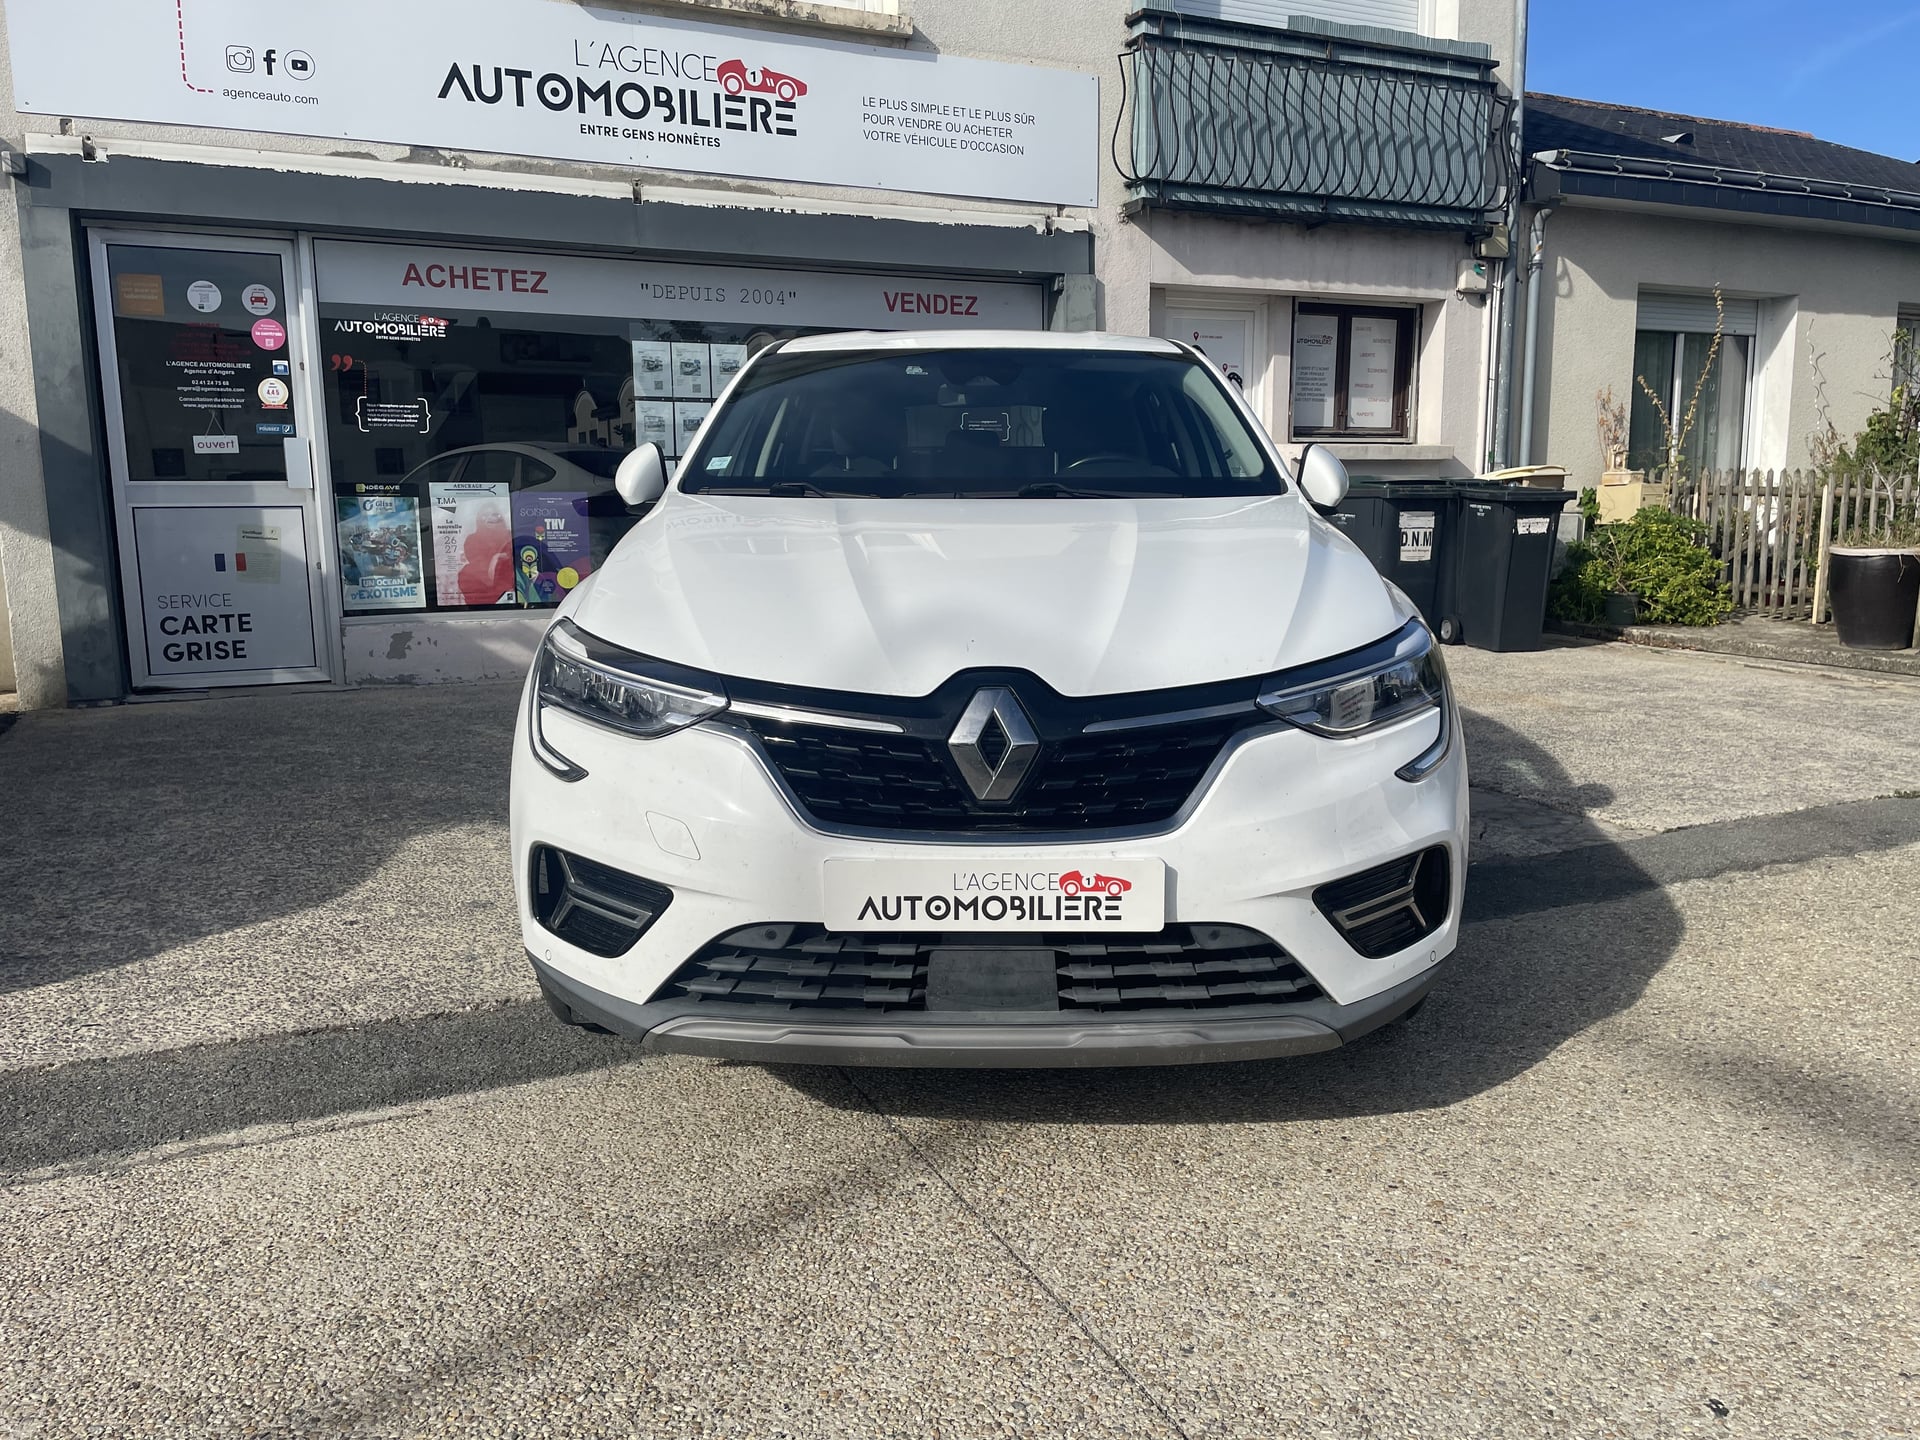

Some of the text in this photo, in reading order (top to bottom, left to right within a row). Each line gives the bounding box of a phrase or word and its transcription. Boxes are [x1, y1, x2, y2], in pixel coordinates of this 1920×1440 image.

[574, 38, 718, 83] L'AGENCE
[222, 88, 319, 105] agenceauto.com
[437, 62, 798, 137] AUTOMOBILIERE
[862, 95, 1036, 126] LE PLUS SIMPLE ET LE PLUS SÛR
[580, 123, 721, 148] ENTRE GENS HONNÊTES
[863, 112, 1013, 139] POUR VENDRE OU ACHETER
[863, 129, 1024, 156] VOTRE VÉHICULE D'OCCASION
[402, 263, 549, 294] ACHETEZ
[883, 291, 979, 316] VENDEZ
[334, 320, 446, 338] AUTOMOBILIERE
[374, 312, 420, 324] L'AGENCE
[165, 360, 252, 369] L'AGENCE AUTOMOBILIERE
[183, 367, 207, 375] Agence
[197, 440, 234, 449] ouvert
[444, 535, 457, 545] 26
[444, 545, 457, 554] 27
[157, 593, 233, 610] SERVICE
[160, 613, 253, 636] CARTE
[163, 640, 248, 663] GRISE
[953, 872, 1060, 892] L'AGENCE
[857, 895, 1123, 921] AUTOMOBILIERE
